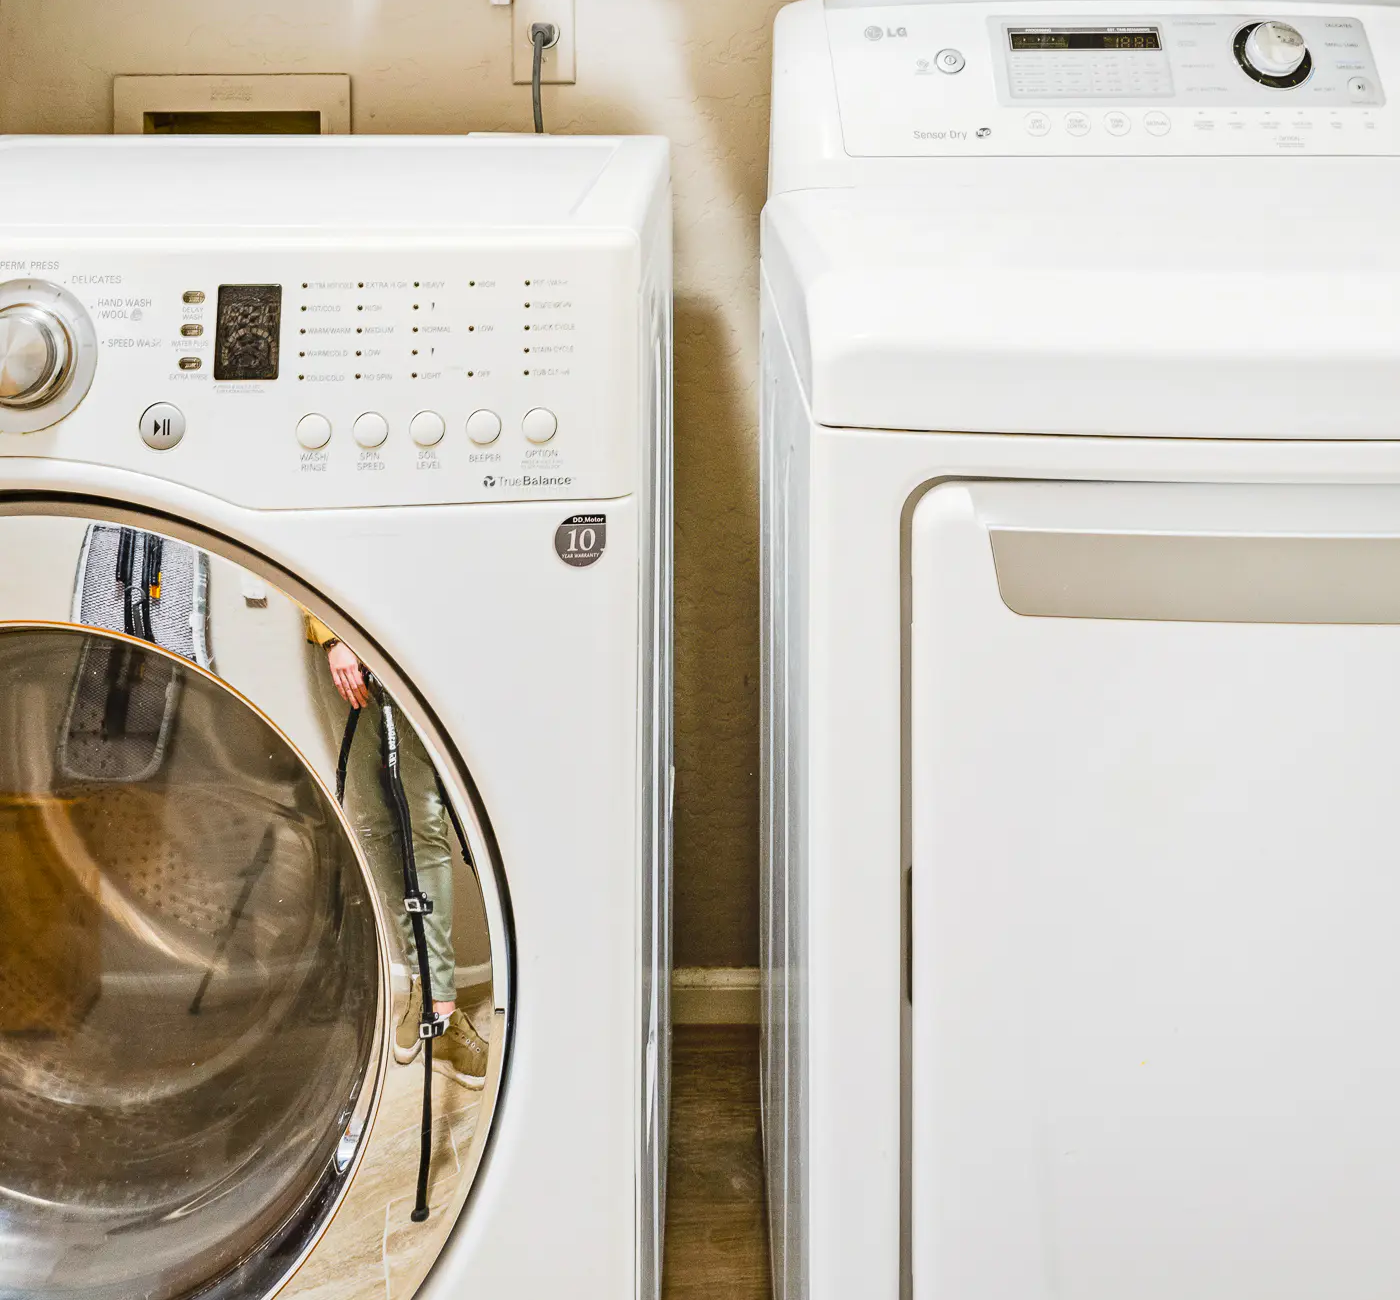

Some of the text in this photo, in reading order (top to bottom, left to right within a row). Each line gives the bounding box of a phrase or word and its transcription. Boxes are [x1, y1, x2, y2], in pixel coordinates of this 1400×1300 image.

[886, 27, 908, 38] LG
[914, 130, 968, 140] Sensor Dry
[30, 262, 60, 270] PRESS
[72, 276, 122, 284] DELICATES
[98, 299, 152, 308] HAND WASH
[97, 310, 129, 319] /WOOL
[108, 339, 134, 348] SPEED
[360, 452, 380, 460] SPIN
[418, 452, 437, 460] SOIL
[468, 454, 502, 462] BEEPER
[525, 450, 558, 458] OPTION
[301, 463, 327, 472] RINSE
[357, 462, 386, 471] SPEED
[416, 461, 442, 470] LEVEL
[499, 475, 572, 487] TrueBalance
[566, 528, 596, 552] 10
